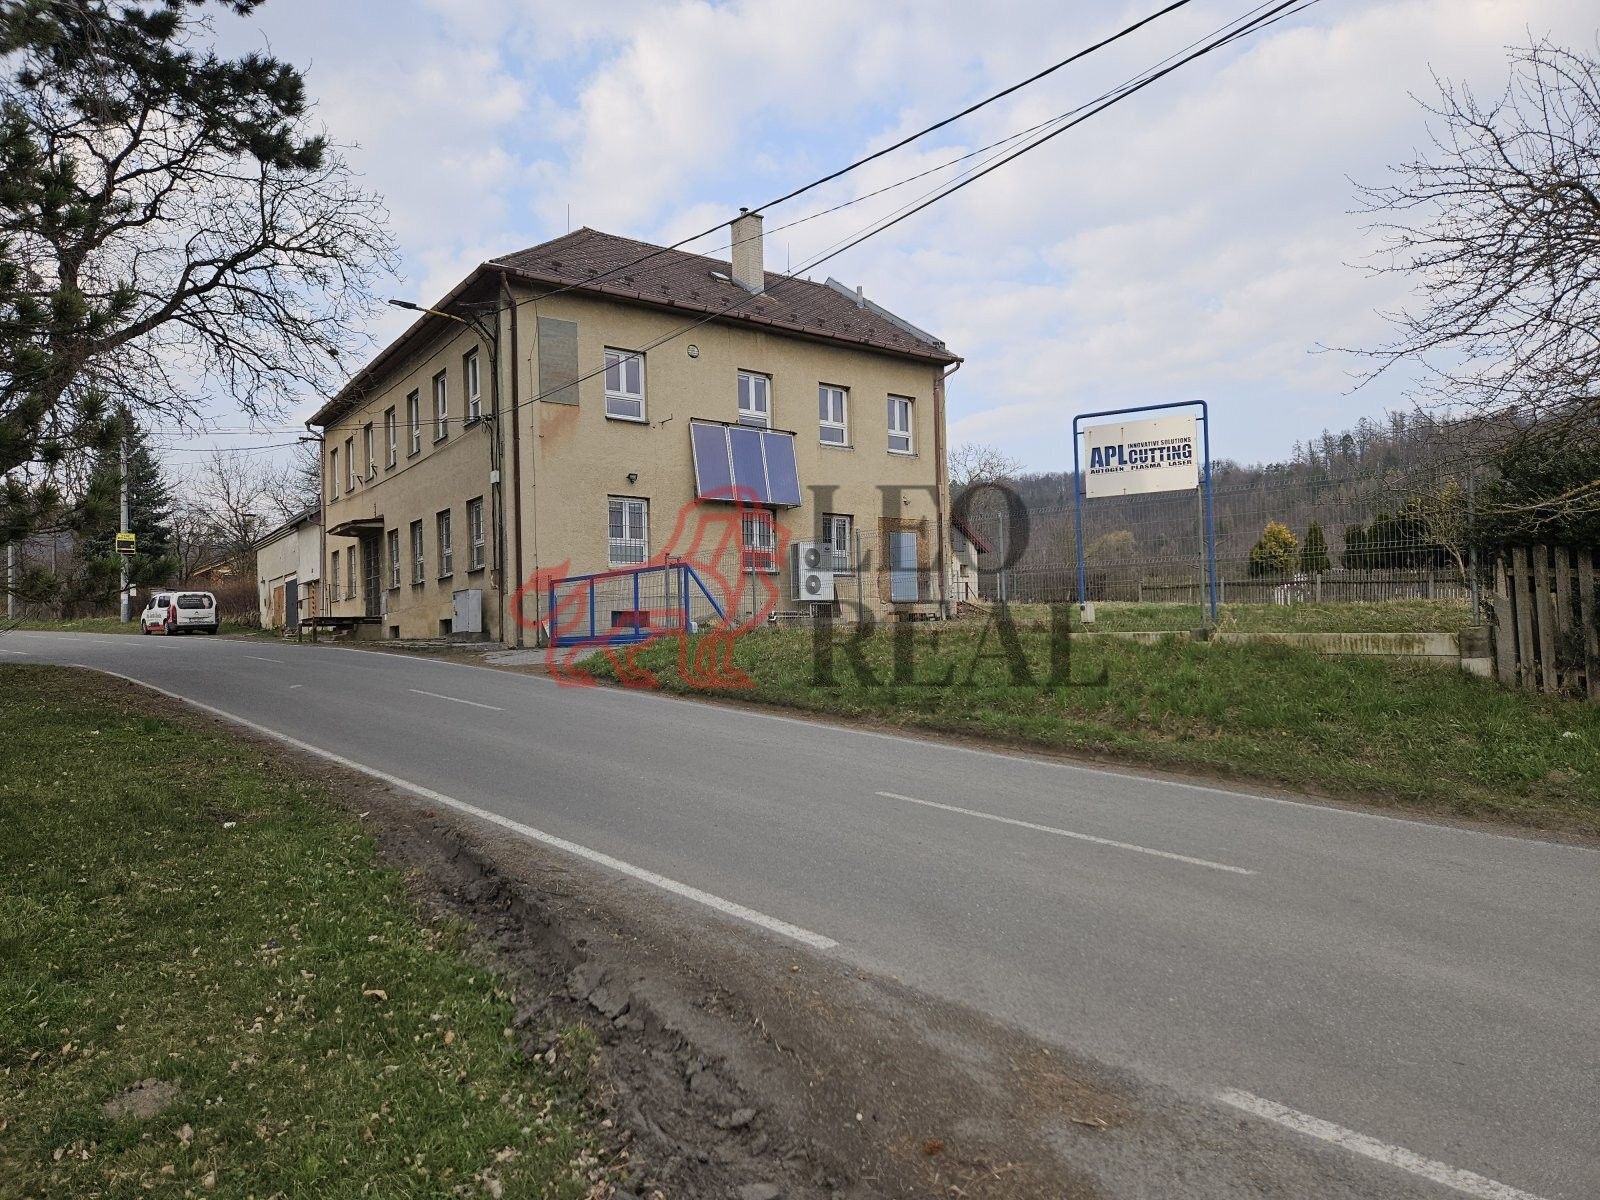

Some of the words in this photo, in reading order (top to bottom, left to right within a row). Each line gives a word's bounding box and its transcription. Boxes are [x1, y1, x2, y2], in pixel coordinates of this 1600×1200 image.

[1128, 441, 1159, 449] INNOVATIVE
[1161, 437, 1191, 445] SOLUTIONS
[1091, 445, 1127, 468] APL
[1129, 443, 1192, 464] CUTTING
